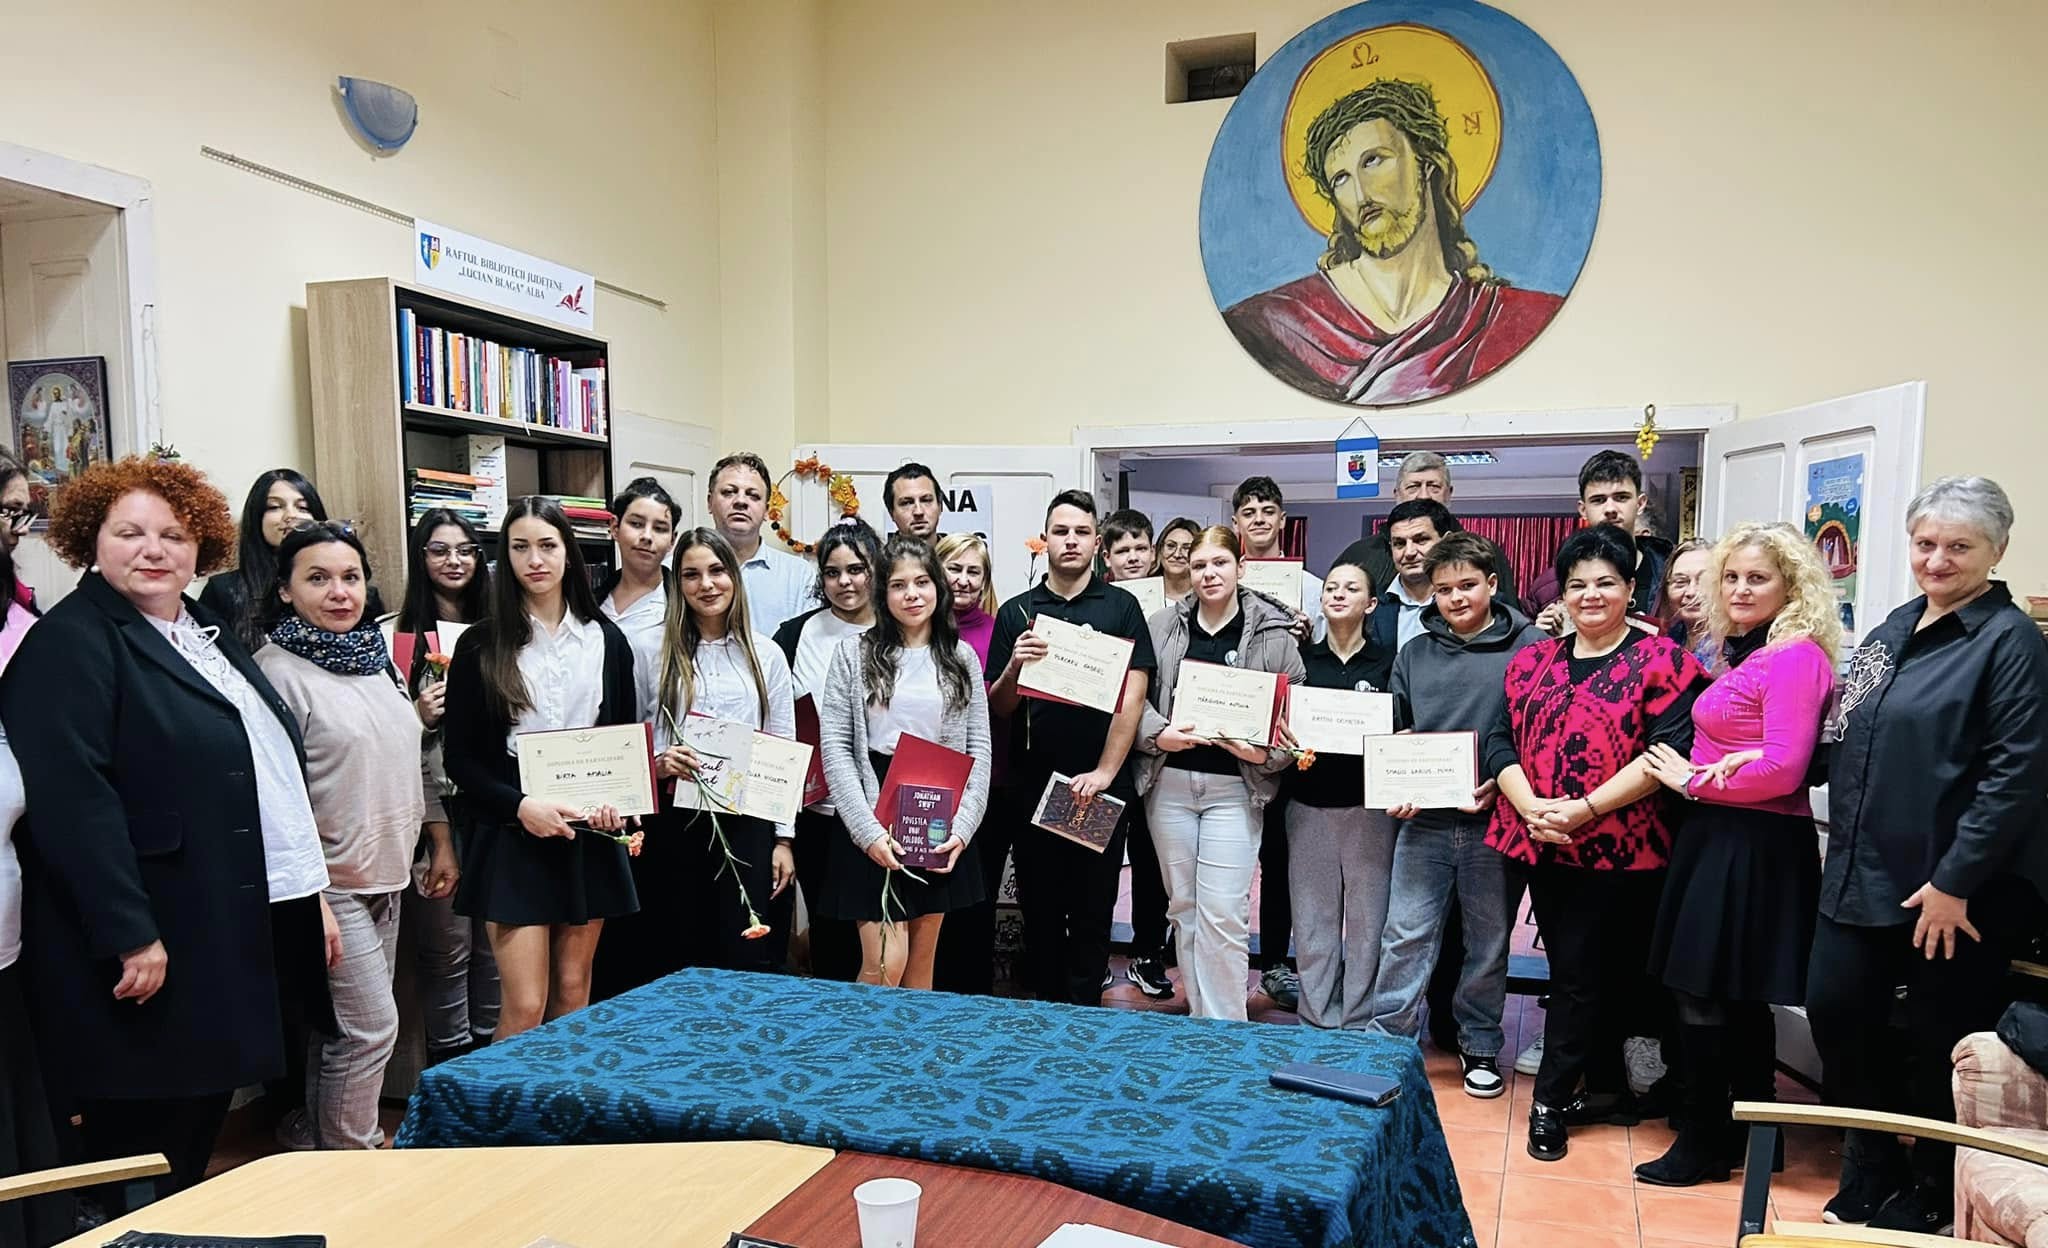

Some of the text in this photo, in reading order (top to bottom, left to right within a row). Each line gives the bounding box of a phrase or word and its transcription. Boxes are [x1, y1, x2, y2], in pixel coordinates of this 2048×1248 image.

[445, 246, 479, 266] RAFTUL
[480, 257, 526, 281] BIBLIOTECII
[527, 285, 545, 300] ALBA
[940, 489, 978, 513] NA
[913, 792, 941, 802] JONATHAN
[918, 800, 936, 809] SWIFT
[902, 815, 928, 826] POVESTEA
